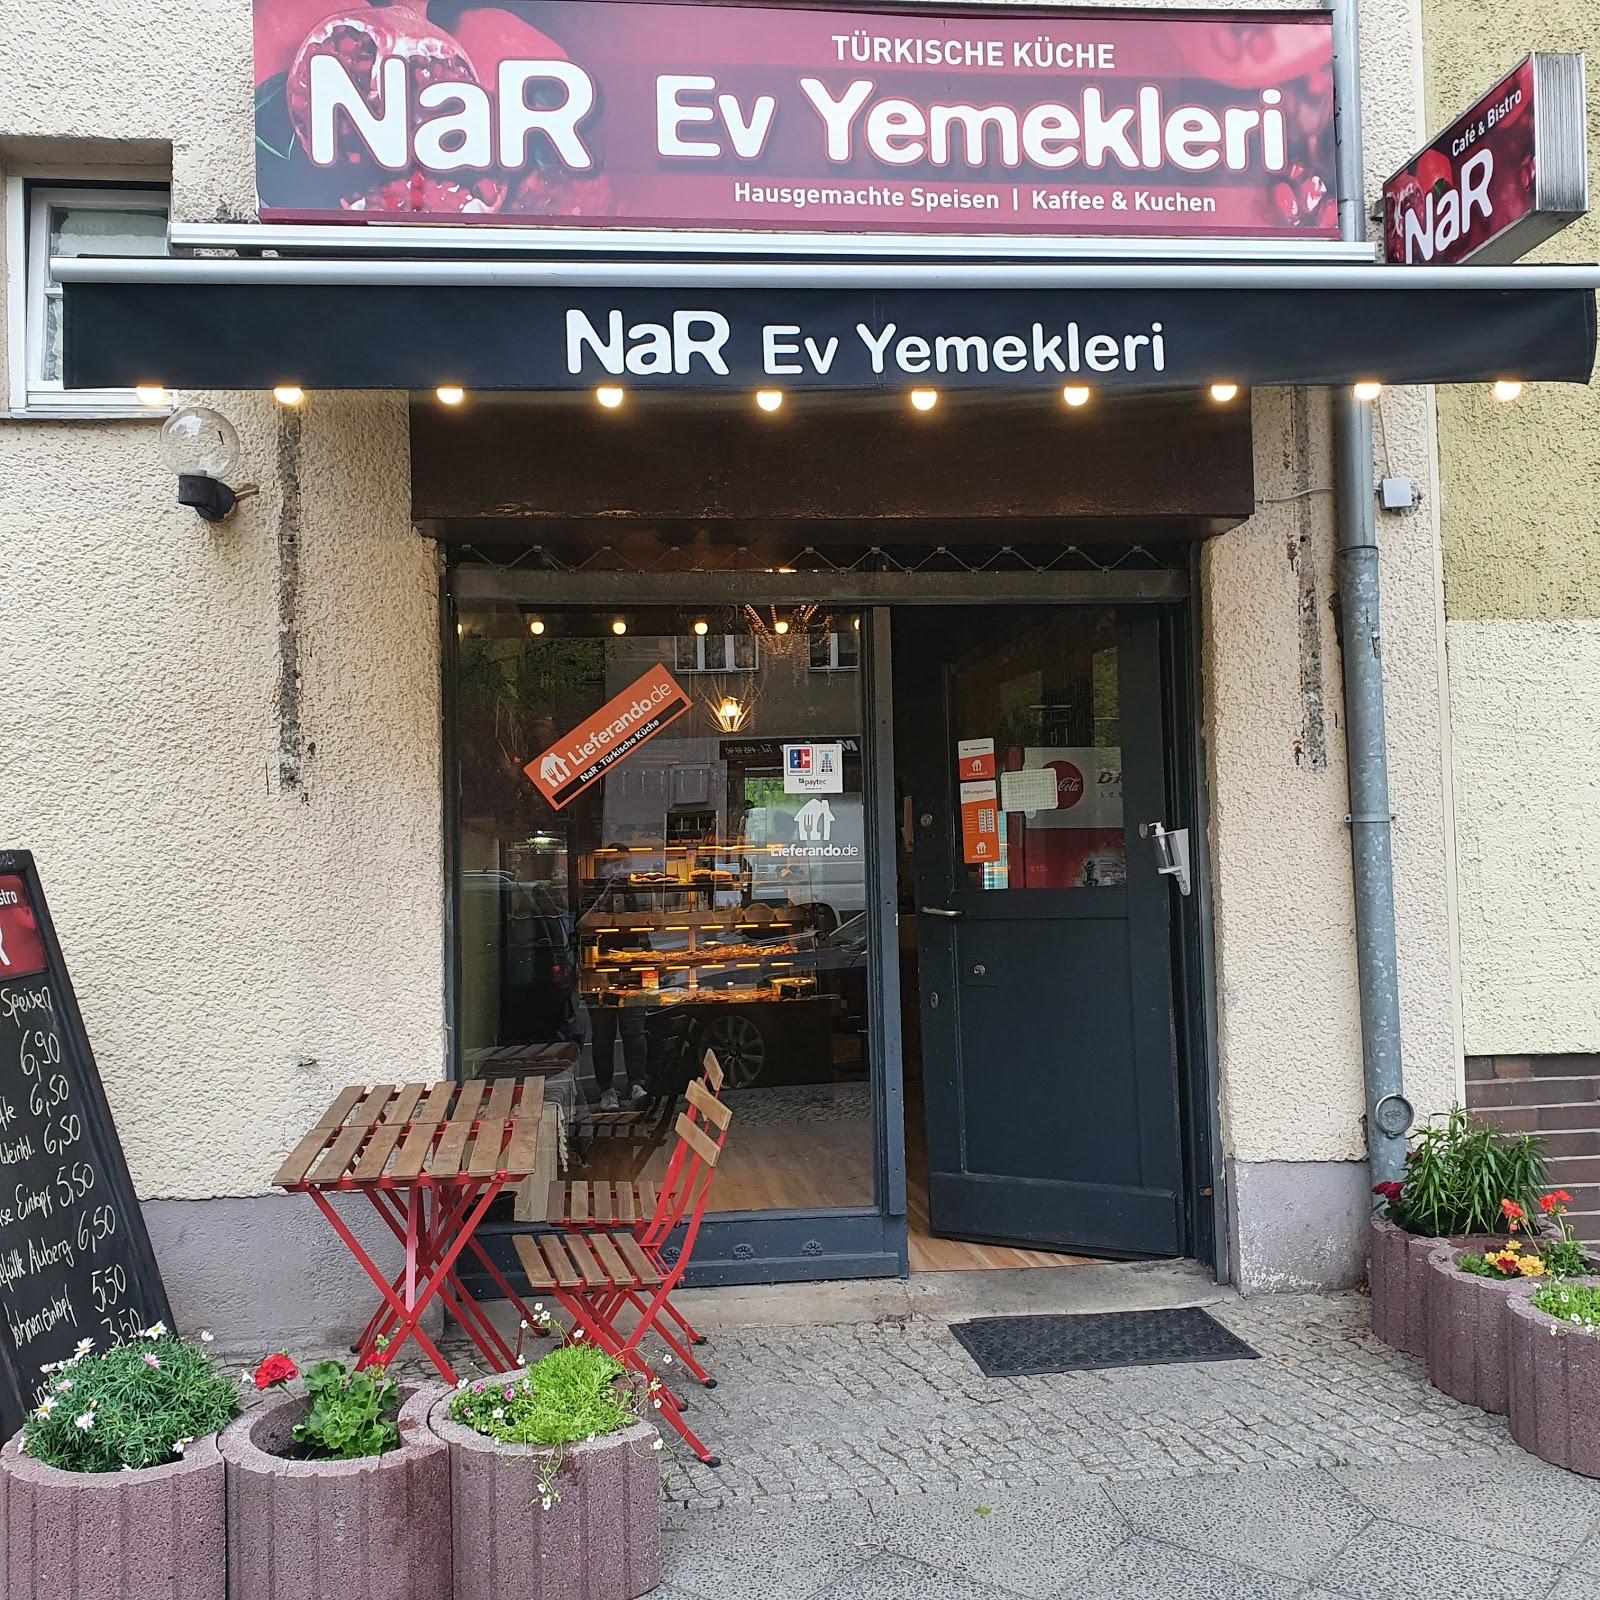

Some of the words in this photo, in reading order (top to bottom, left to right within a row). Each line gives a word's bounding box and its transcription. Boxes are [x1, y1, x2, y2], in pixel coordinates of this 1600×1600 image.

[832, 31, 1004, 67] TÜRKISCHE
[1012, 37, 1115, 69] KÜCHE
[309, 54, 594, 169] NaR
[656, 74, 776, 158] Ev
[800, 78, 1286, 171] Yemekleri
[1451, 123, 1476, 157] Café
[1487, 89, 1522, 129] Bistro
[733, 182, 904, 208] Hausgemachte
[910, 187, 999, 211] Speisen
[1032, 189, 1105, 211] Kaffee
[1111, 192, 1129, 210] &
[1134, 190, 1216, 212] Kuchen
[1405, 148, 1494, 264] NaR
[566, 309, 731, 375] NaR
[763, 324, 839, 375] Ev
[855, 321, 1166, 373] Yemekleri
[567, 682, 672, 767] Lieferando.de
[580, 765, 599, 782] NaR
[599, 736, 637, 767] Türkische
[634, 719, 660, 741] Küche
[770, 843, 859, 857] Lieferando.de
[20, 1030, 60, 1082] 6,90
[29, 1074, 69, 1117] 6,50
[44, 1114, 81, 1156] 6,50
[56, 1161, 94, 1207] 5,50
[77, 1204, 116, 1254] 6,50
